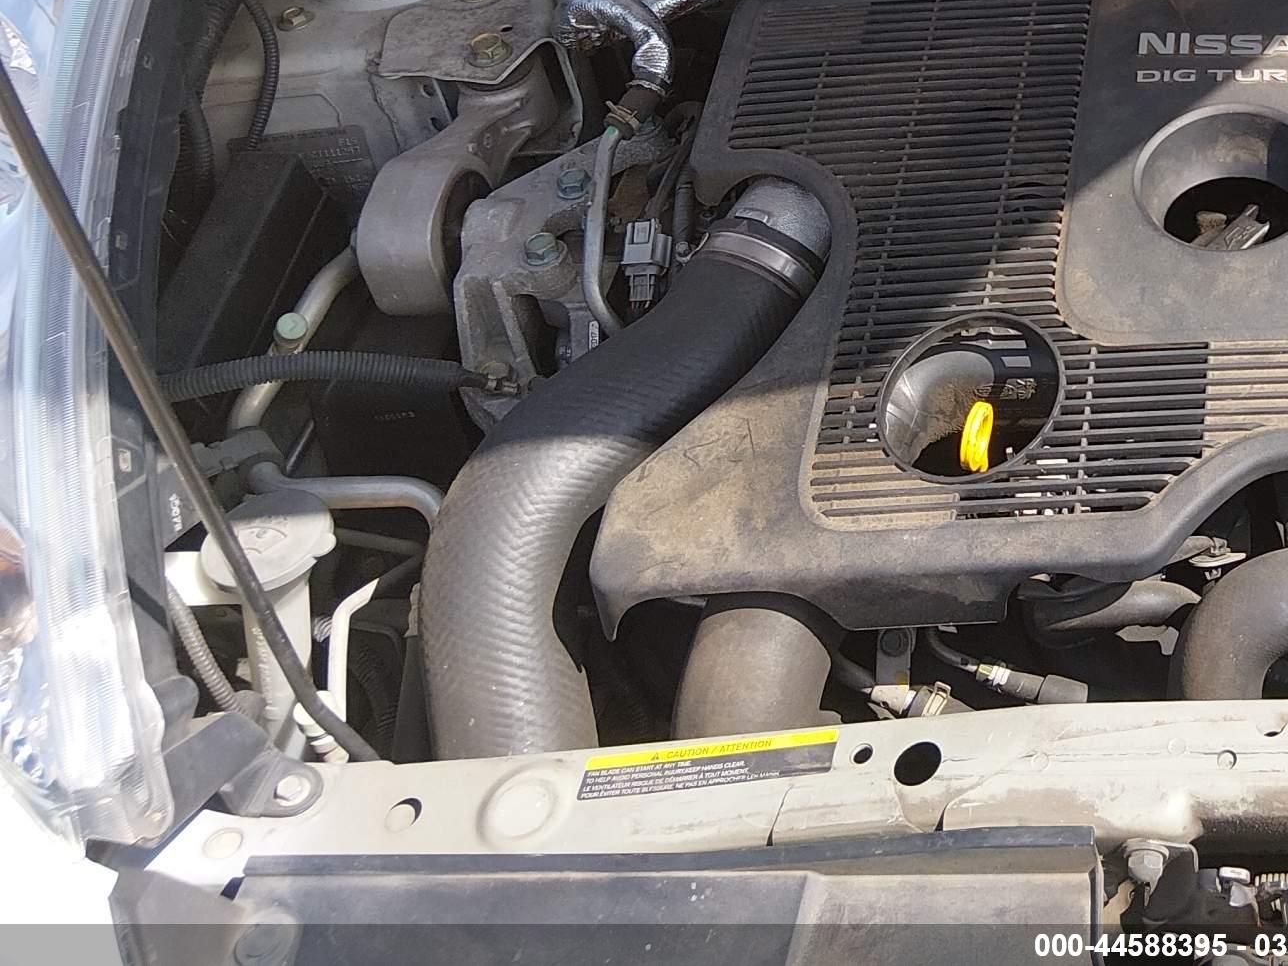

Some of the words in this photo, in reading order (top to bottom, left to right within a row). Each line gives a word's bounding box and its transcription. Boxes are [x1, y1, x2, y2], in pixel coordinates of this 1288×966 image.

[1136, 69, 1198, 84] DIG
[666, 747, 710, 759] CAUTION
[720, 740, 773, 753] ATTENTION
[631, 770, 664, 779] PERSONAL
[701, 762, 724, 770] HANDS
[592, 781, 631, 790] VENTILATEUR
